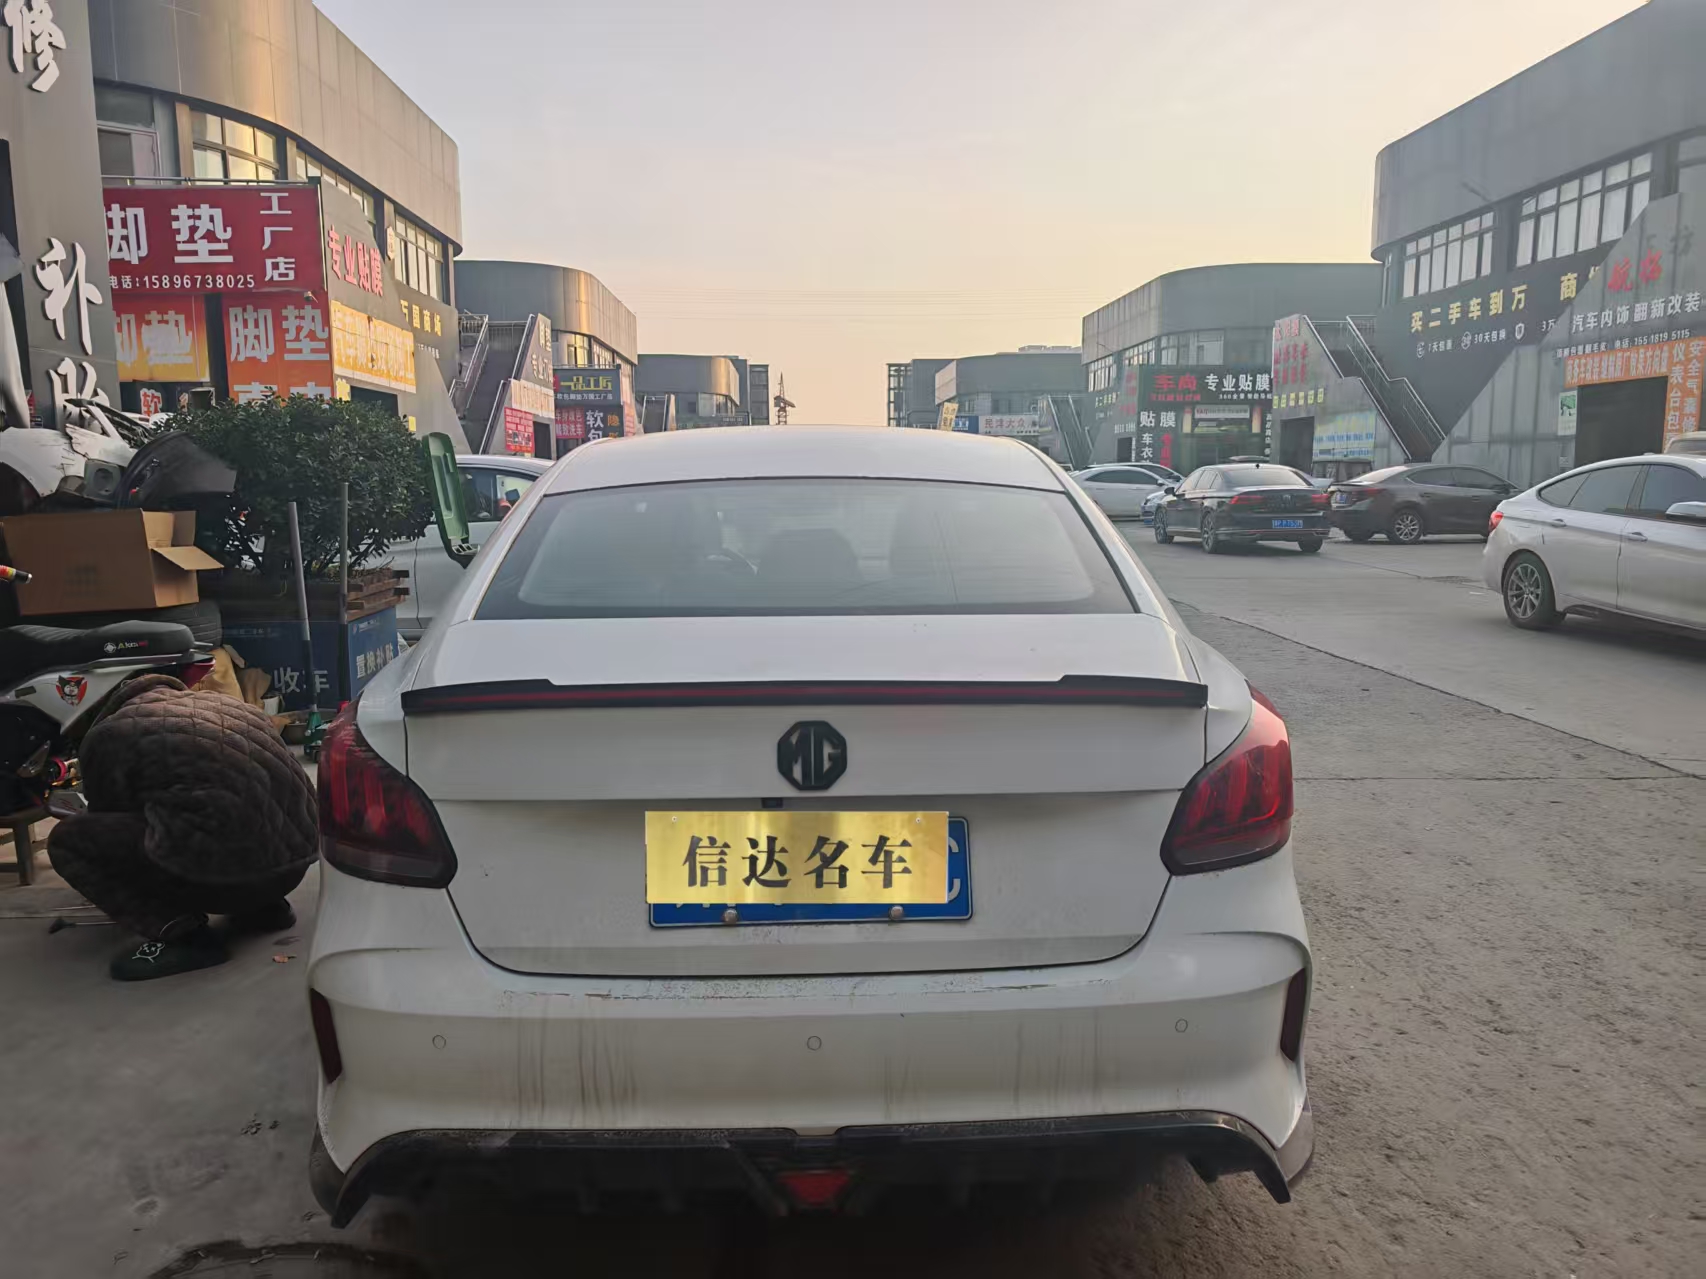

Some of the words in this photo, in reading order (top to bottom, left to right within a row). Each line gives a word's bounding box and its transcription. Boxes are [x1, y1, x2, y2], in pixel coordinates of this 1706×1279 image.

[259, 192, 296, 282] 工厂店
[328, 224, 383, 297] 专业贴膜
[229, 304, 329, 363] 脚垫
[1571, 291, 1701, 334] 汽车内饰翻新改装
[1204, 373, 1271, 392] 专业贴膜
[586, 410, 604, 440] 软包
[1139, 410, 1176, 428] 贴膜
[779, 723, 846, 789] MG
[682, 835, 912, 889] 信达名车
